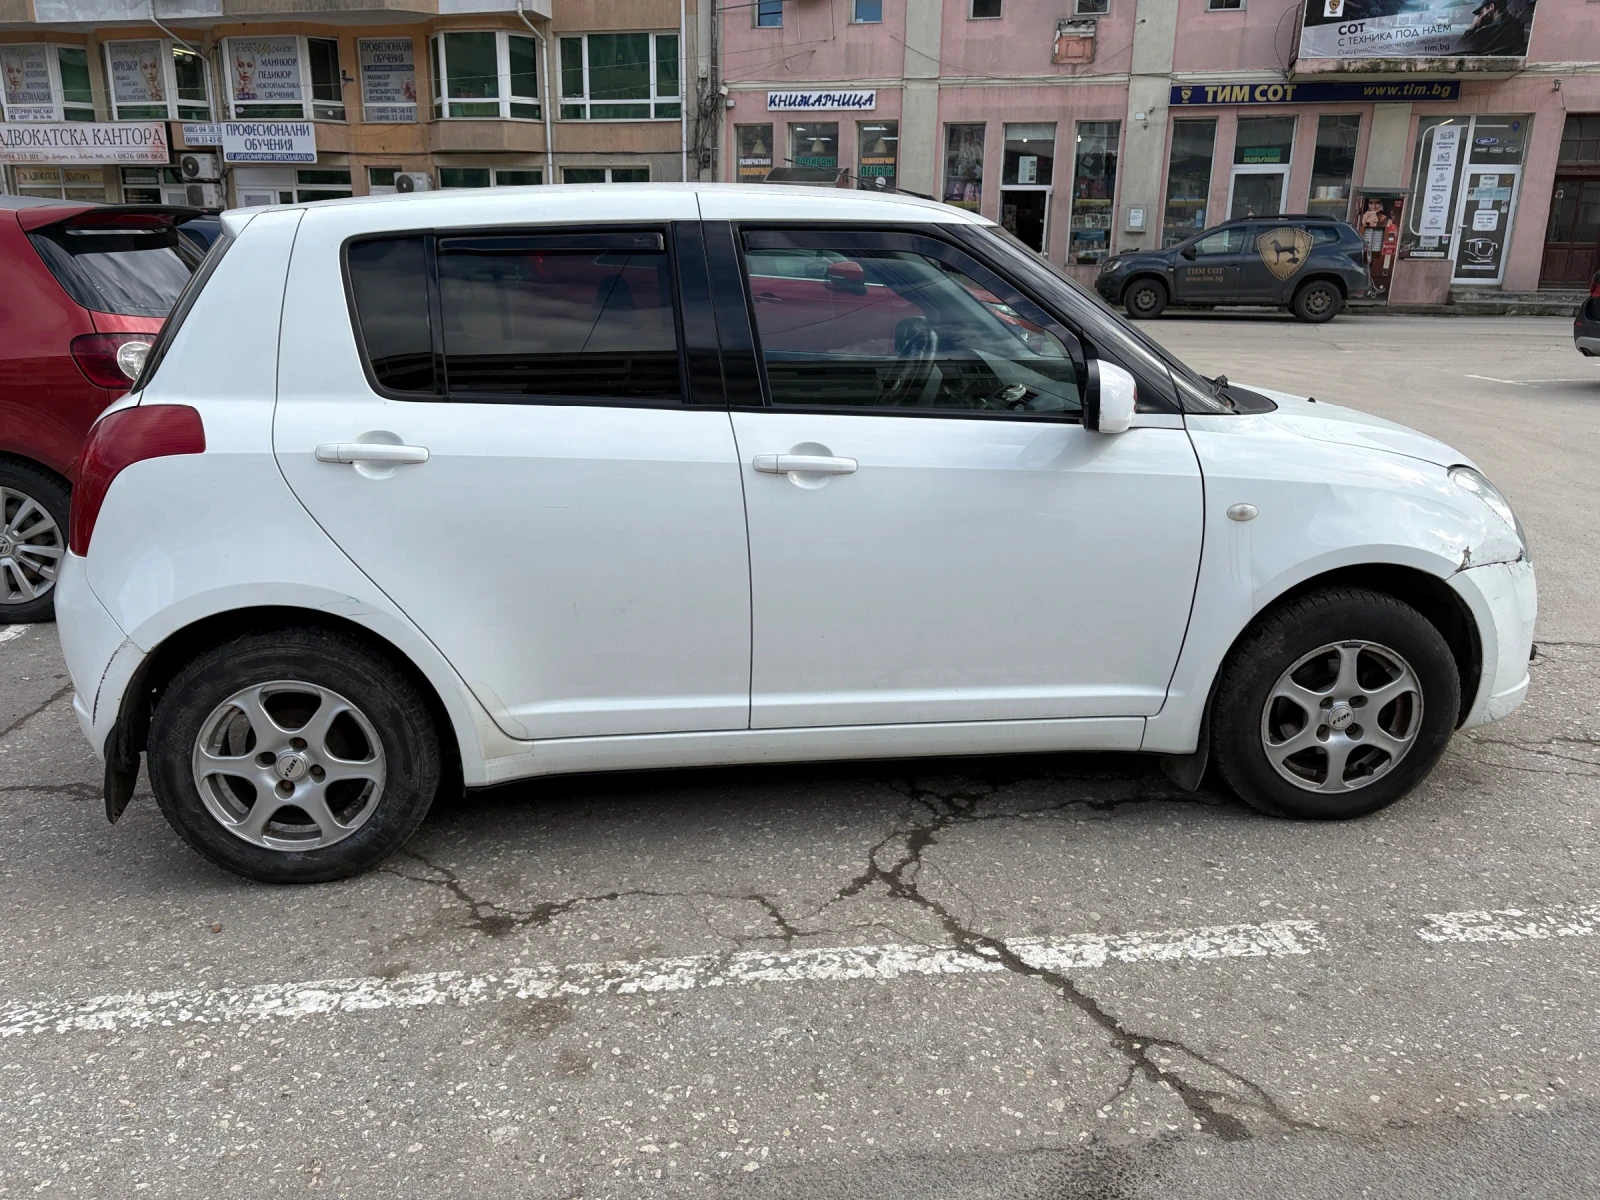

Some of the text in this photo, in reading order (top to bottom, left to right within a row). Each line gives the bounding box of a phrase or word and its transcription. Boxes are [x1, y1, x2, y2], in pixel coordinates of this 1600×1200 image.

[1338, 22, 1366, 36] СОТ
[1338, 23, 1452, 47] С ТЕХНИКА ПОД НАЕМ
[1424, 43, 1450, 53] tim.bg
[261, 58, 297, 67] МАНИКЮР
[373, 53, 405, 63] ОБУЧЕНИЯ
[258, 70, 292, 79] ПЕДИКЮР
[264, 91, 296, 99] ОБУЧЕНИЕ
[1204, 84, 1297, 103] ТИМ СОТ
[1363, 83, 1451, 97] www.tim.bg
[768, 93, 875, 109] КНИЖАРНИЦА
[226, 123, 310, 137] ПРОФЕСИОНАЛНИ
[0, 127, 164, 148] АДВОКАТСКА КАНТОРА
[244, 138, 293, 151] ОБУЧЕНИЯ
[795, 157, 836, 167] КОПИРАНЕ
[860, 165, 894, 177] ПЕЧАТИ
[1187, 267, 1224, 275] ТИМ СОТ
